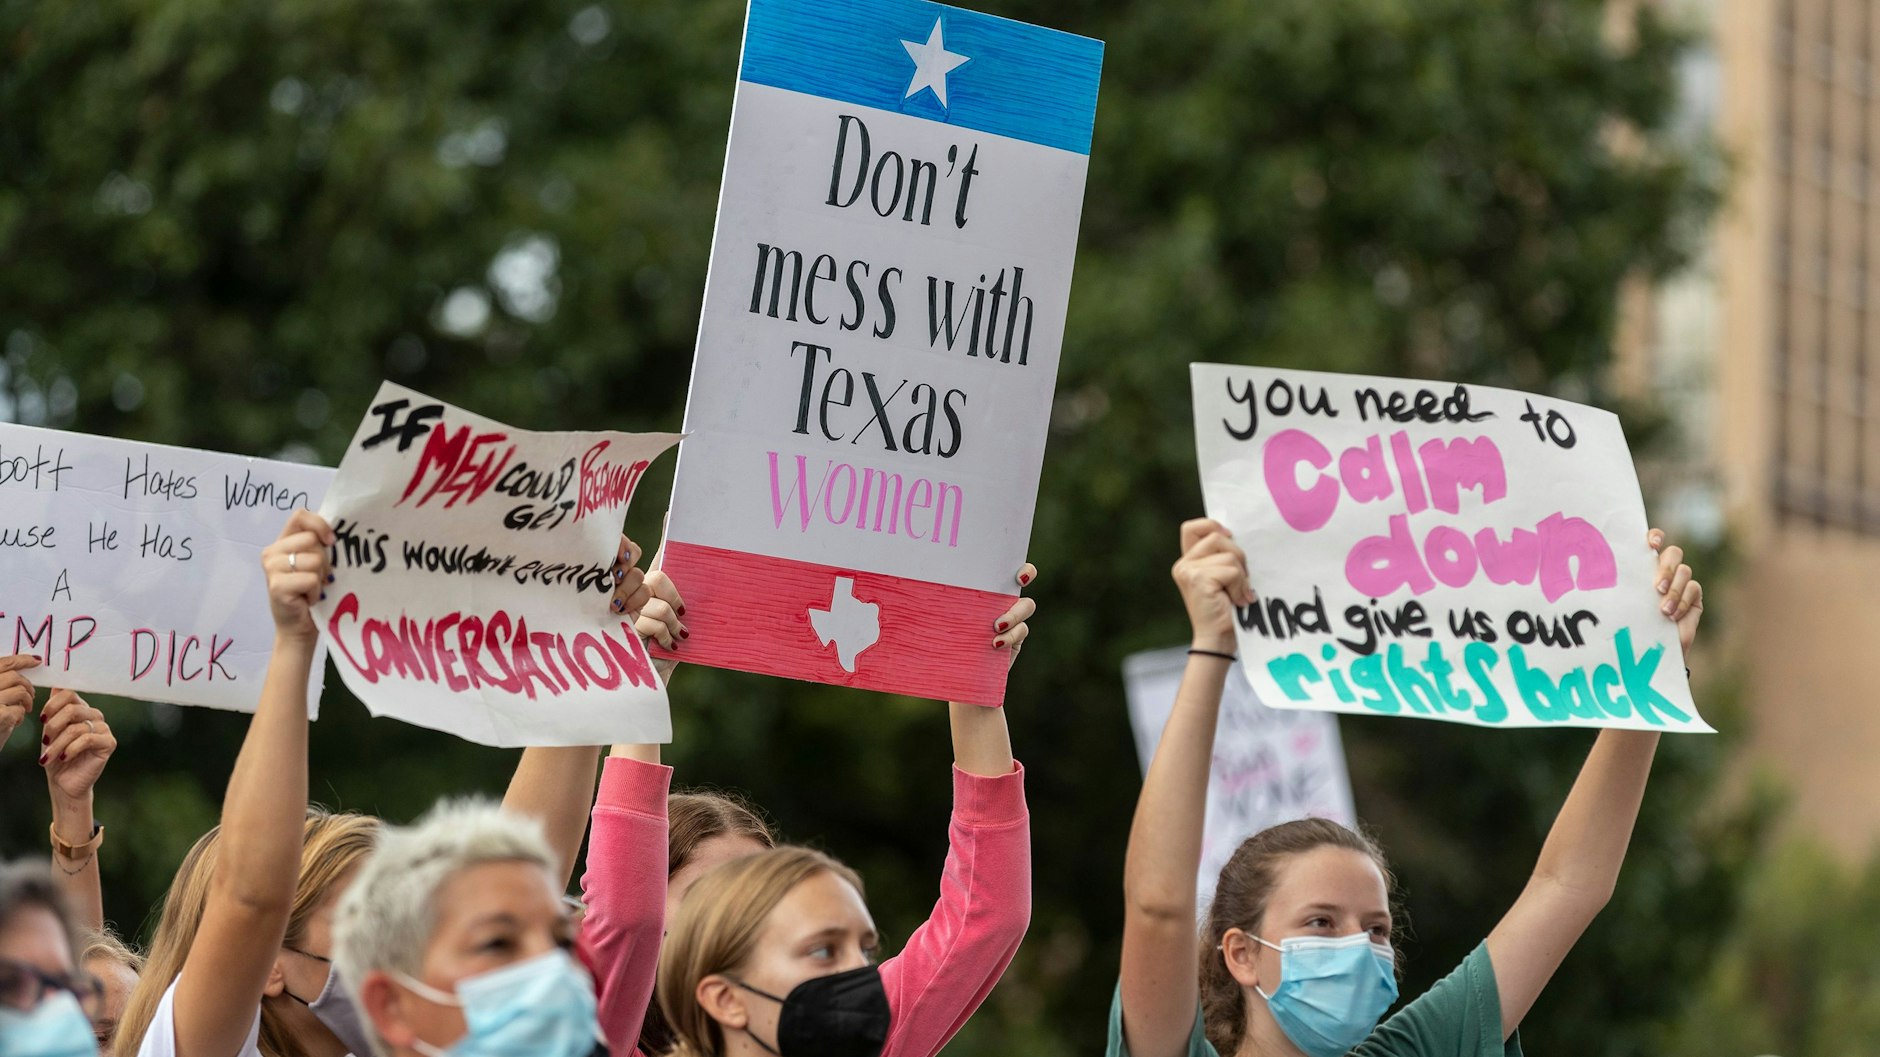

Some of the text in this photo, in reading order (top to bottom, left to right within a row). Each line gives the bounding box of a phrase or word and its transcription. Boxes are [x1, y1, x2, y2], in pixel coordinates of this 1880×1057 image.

[825, 114, 979, 229] Don't
[748, 242, 1034, 367] mess with
[790, 341, 968, 459] Texas
[1223, 376, 1577, 450] you need to
[124, 453, 197, 500] Hates
[224, 469, 310, 511] Women
[361, 398, 577, 509] IF MEN COULD
[766, 451, 964, 547] Women
[1263, 429, 1508, 533] Calm
[88, 521, 120, 553] He
[140, 523, 193, 561] Has
[503, 500, 576, 531] GET
[1344, 510, 1618, 604] down
[51, 568, 72, 601] A
[1235, 584, 1600, 656] and give us our
[0, 611, 237, 687] MP DICK
[328, 592, 658, 700] CONVERSATION
[1507, 626, 1693, 726] back
